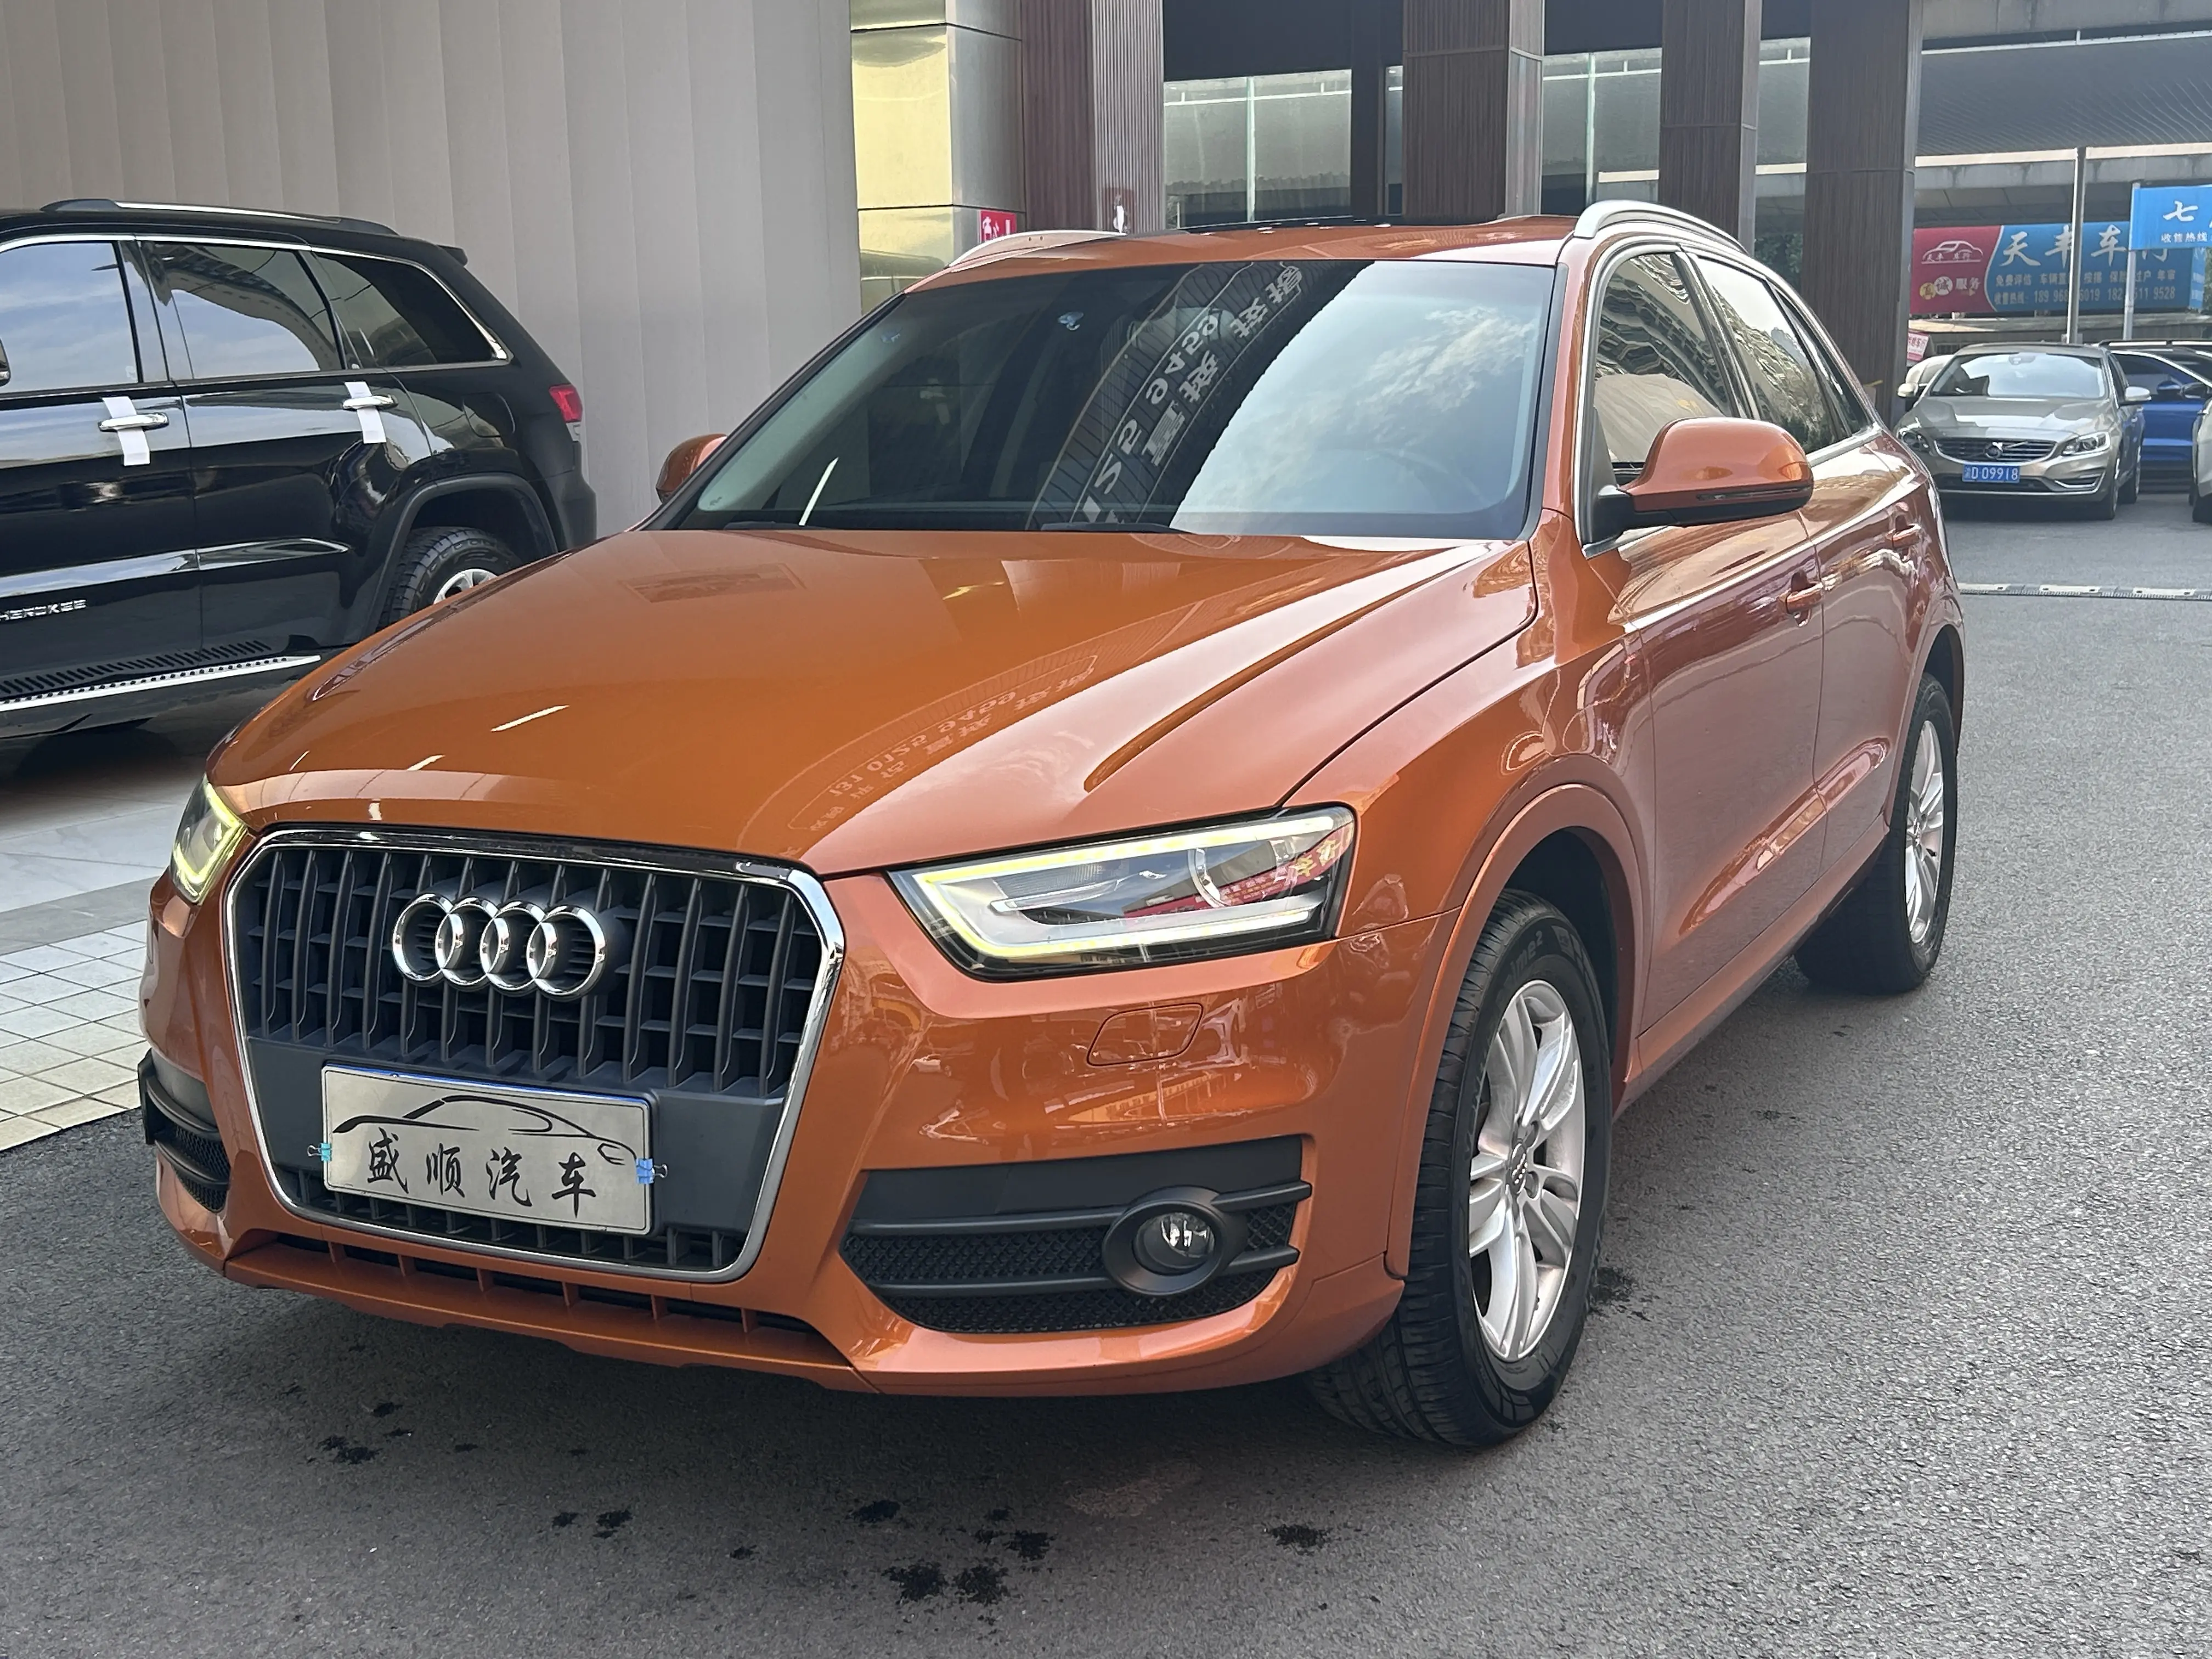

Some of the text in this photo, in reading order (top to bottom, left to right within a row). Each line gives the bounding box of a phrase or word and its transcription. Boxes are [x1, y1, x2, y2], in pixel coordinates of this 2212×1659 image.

[2040, 273, 2067, 285] 车辆置
[367, 1128, 596, 1217] 盛顺汽车
